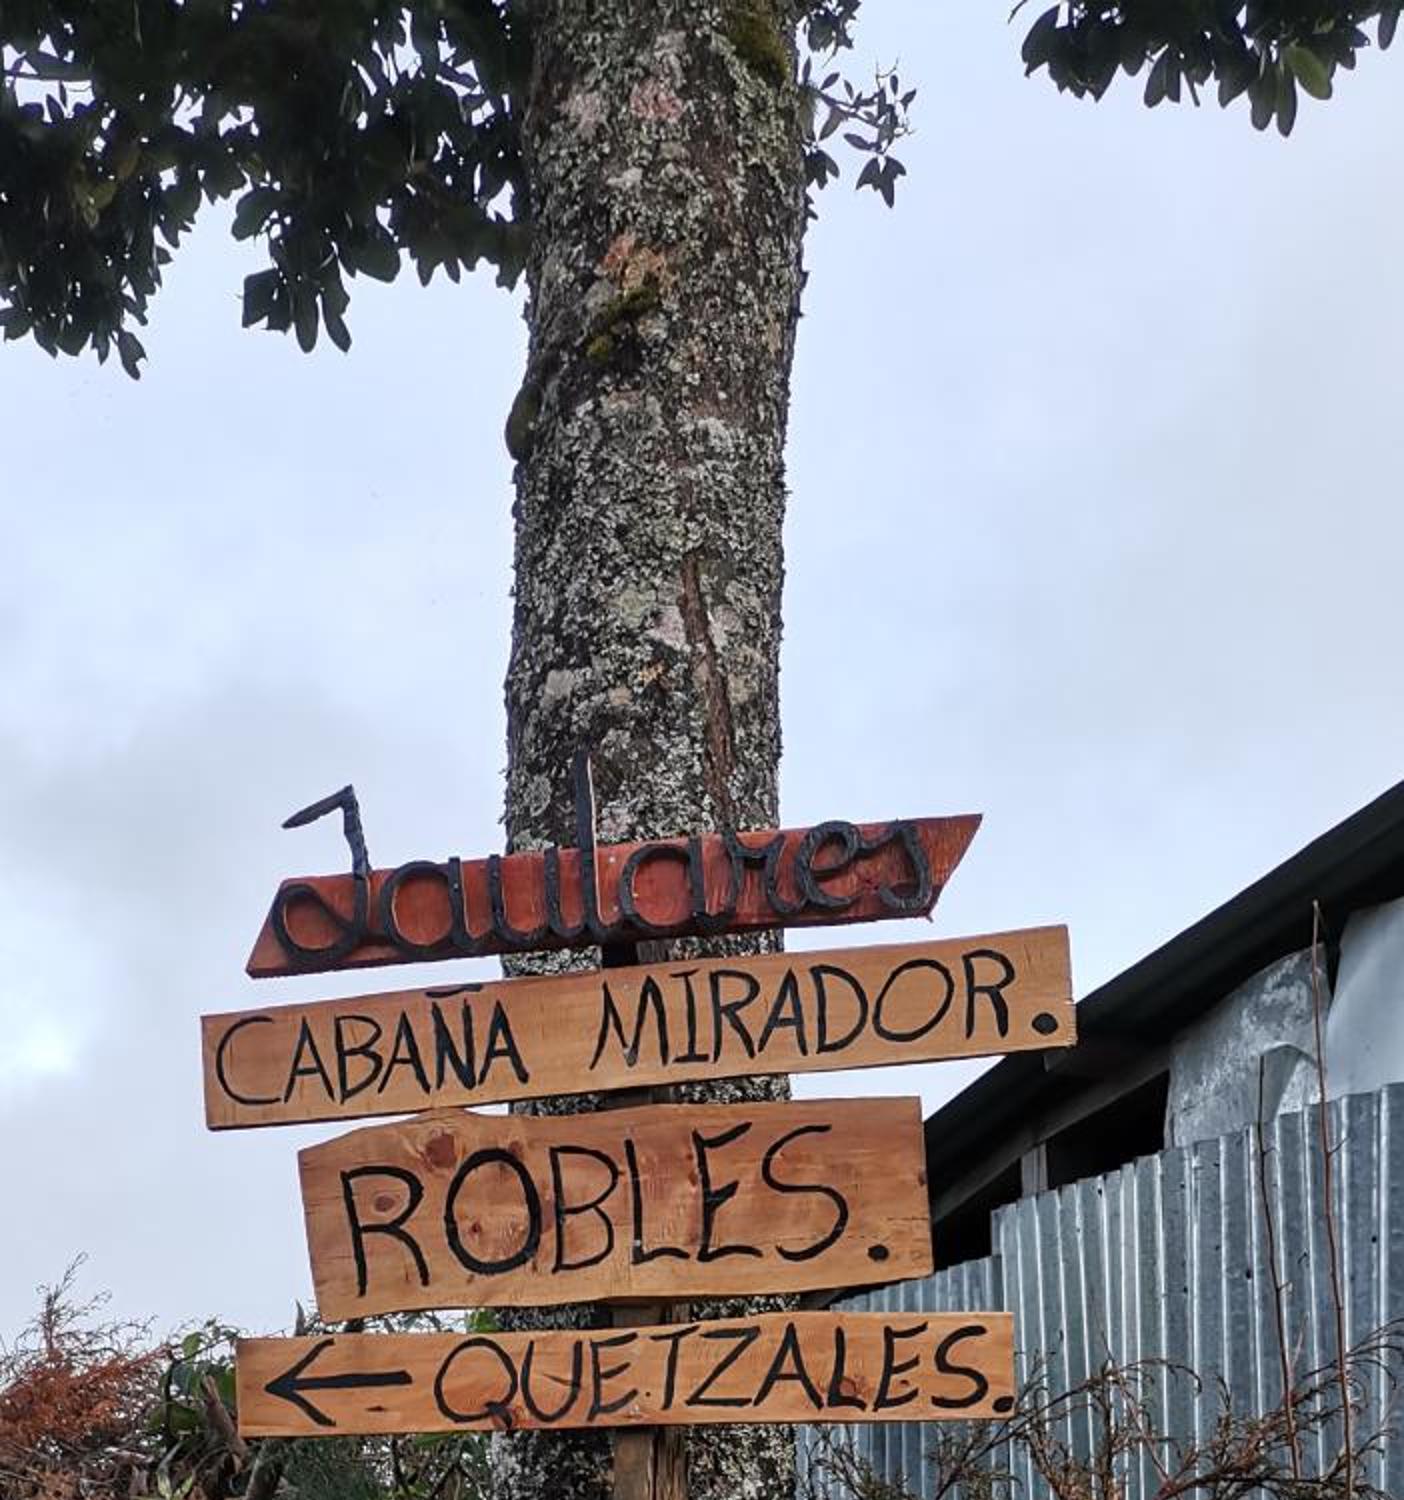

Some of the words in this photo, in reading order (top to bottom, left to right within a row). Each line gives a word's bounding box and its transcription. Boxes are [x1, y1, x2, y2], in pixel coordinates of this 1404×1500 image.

[214, 987, 531, 1106] CABAÑA
[589, 948, 1061, 1071] MIRADOR.
[340, 1122, 889, 1297] ROBLES.
[434, 1324, 1015, 1430] QUETZALES.
